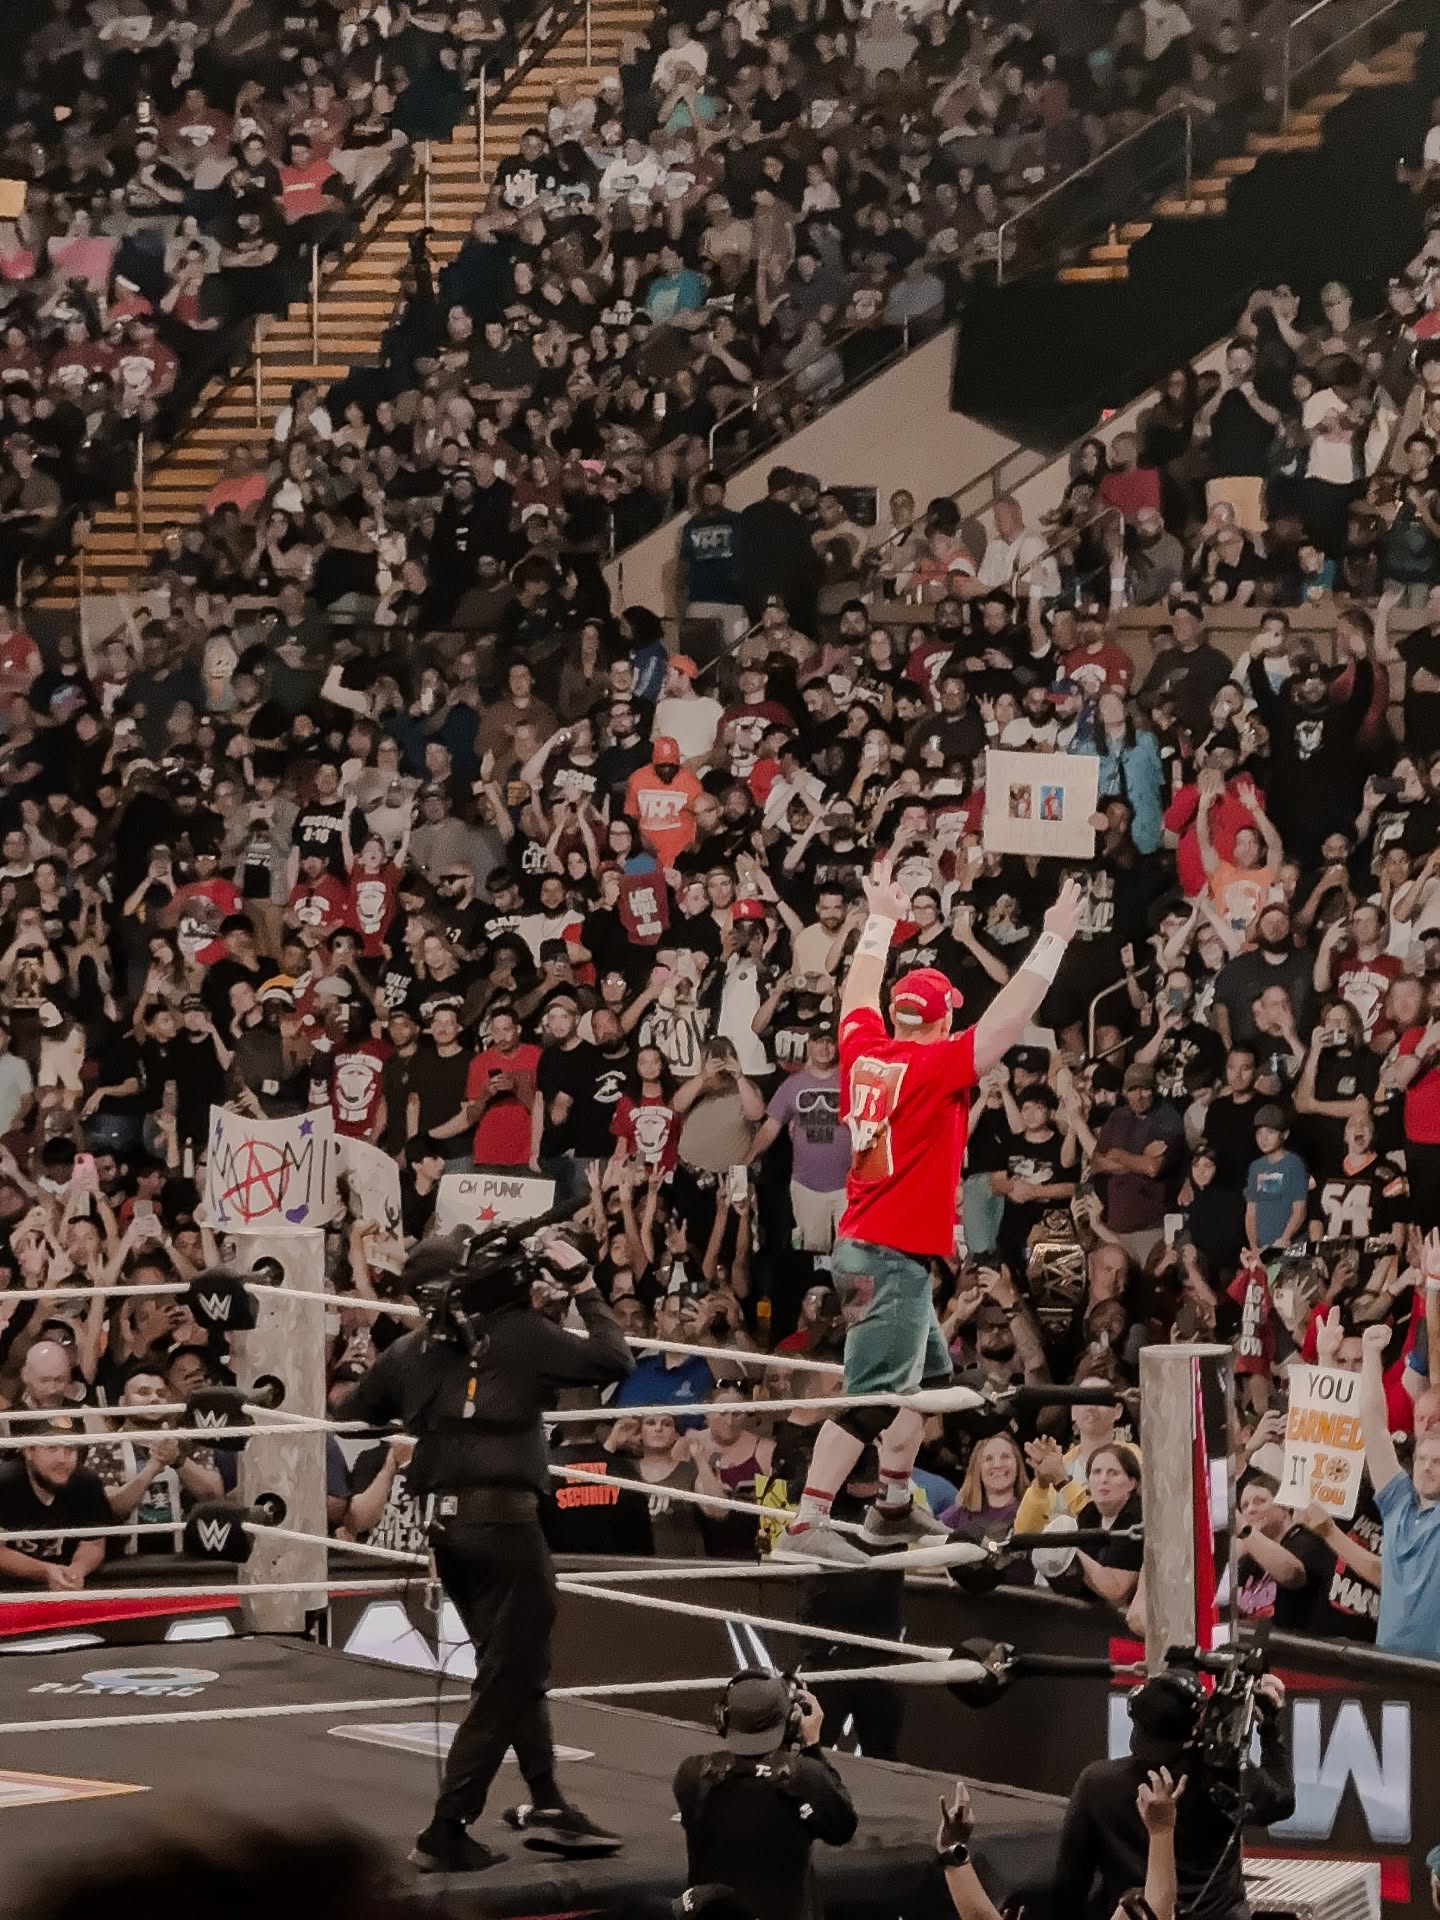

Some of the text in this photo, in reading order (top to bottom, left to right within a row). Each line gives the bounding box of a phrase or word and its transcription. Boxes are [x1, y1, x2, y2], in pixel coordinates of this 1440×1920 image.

[209, 1137, 329, 1224] MAMI
[458, 1180, 525, 1198] CM PUNK
[1308, 1372, 1355, 1403] YOU
[1287, 1407, 1365, 1450] EARNED
[556, 1484, 620, 1509] SECURITY
